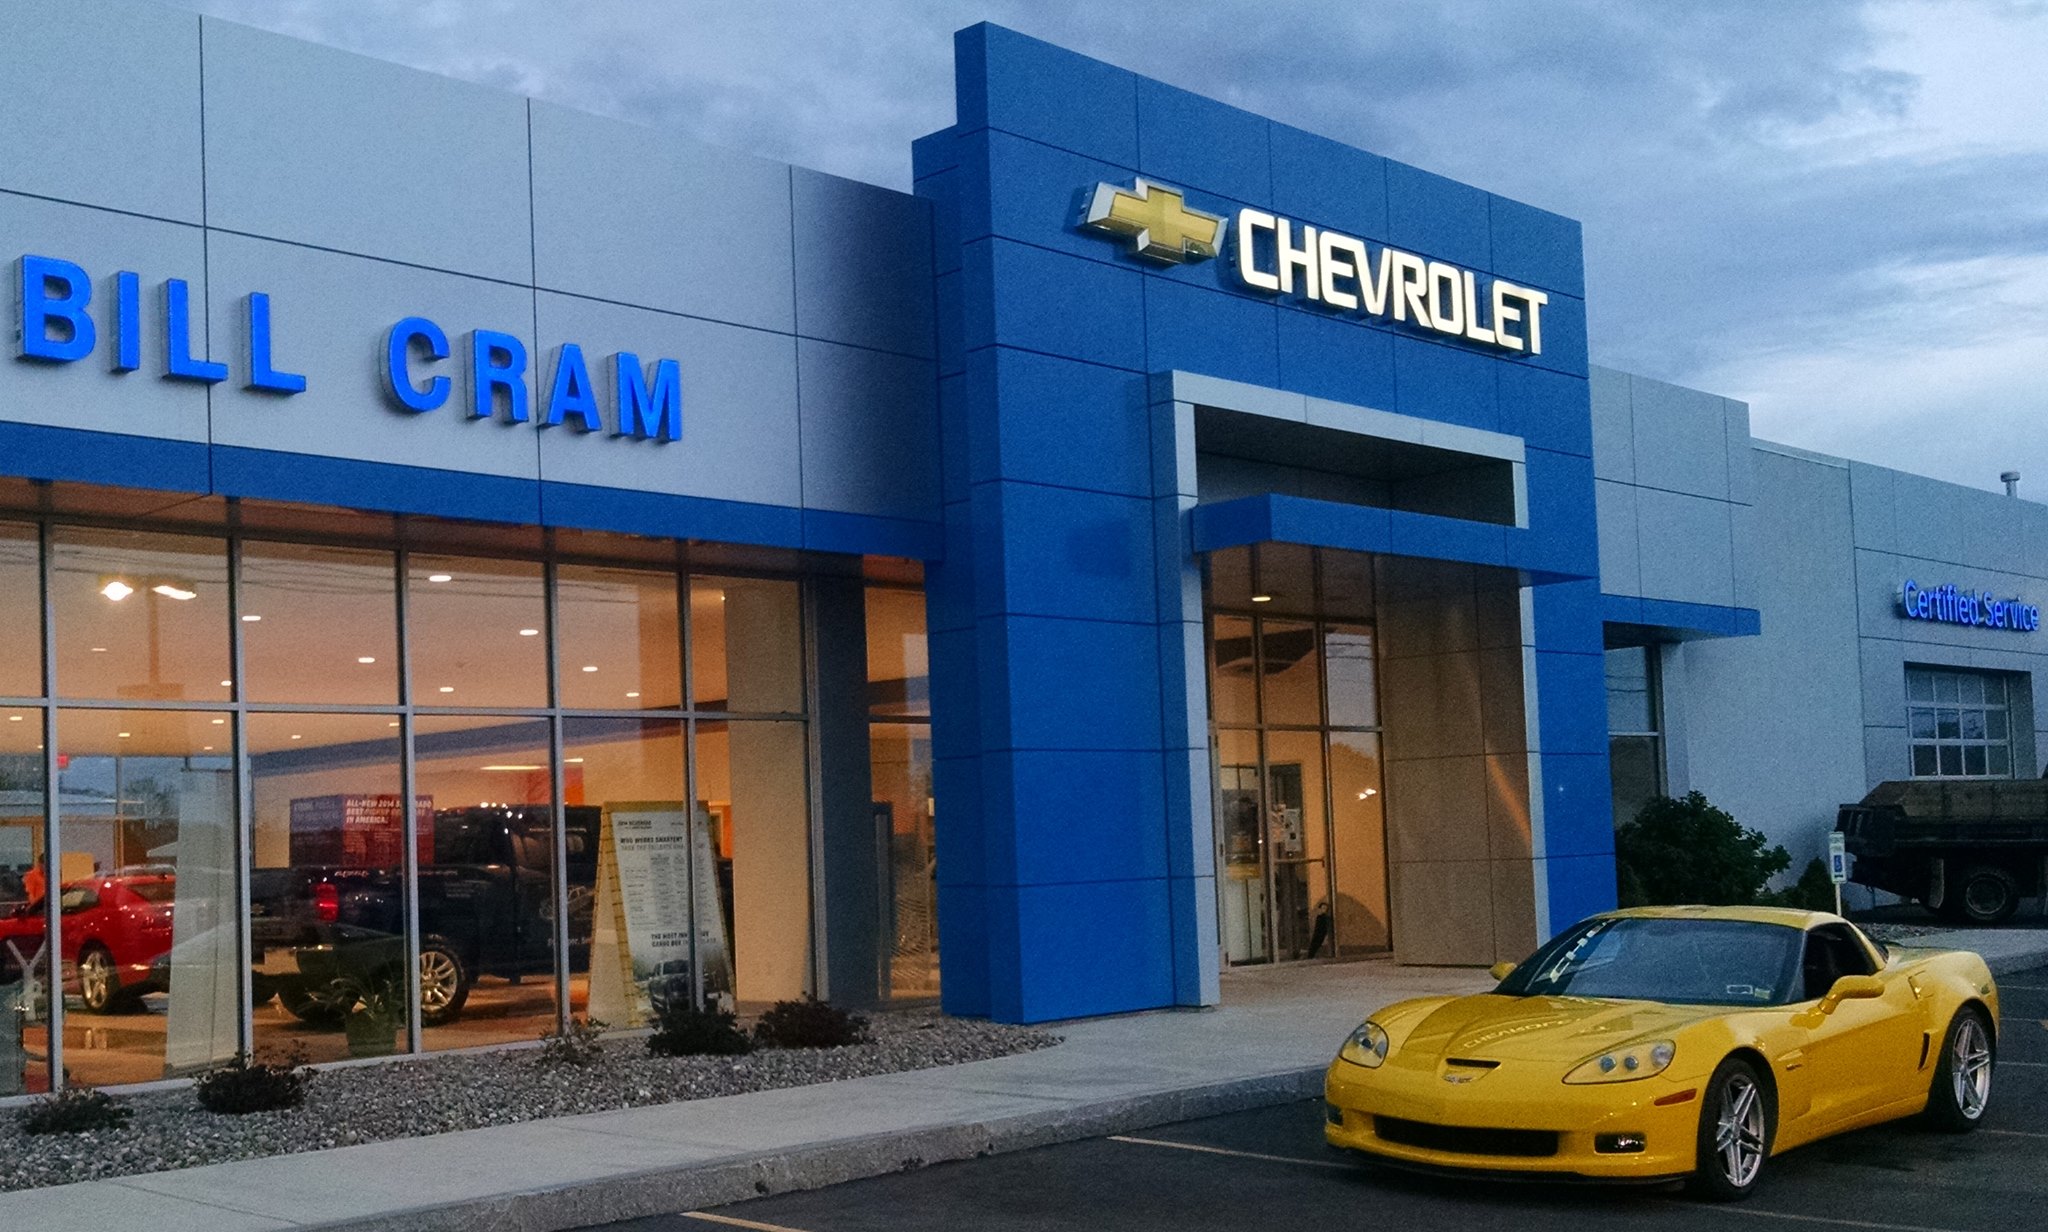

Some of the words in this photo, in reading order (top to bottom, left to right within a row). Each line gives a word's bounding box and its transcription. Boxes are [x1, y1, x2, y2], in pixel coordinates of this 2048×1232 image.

[17, 254, 306, 395] BILL
[383, 316, 682, 442] CRAM
[1238, 208, 1548, 356] CHEVROLET
[1904, 579, 1979, 625] Certified
[1983, 591, 2039, 631] Service
